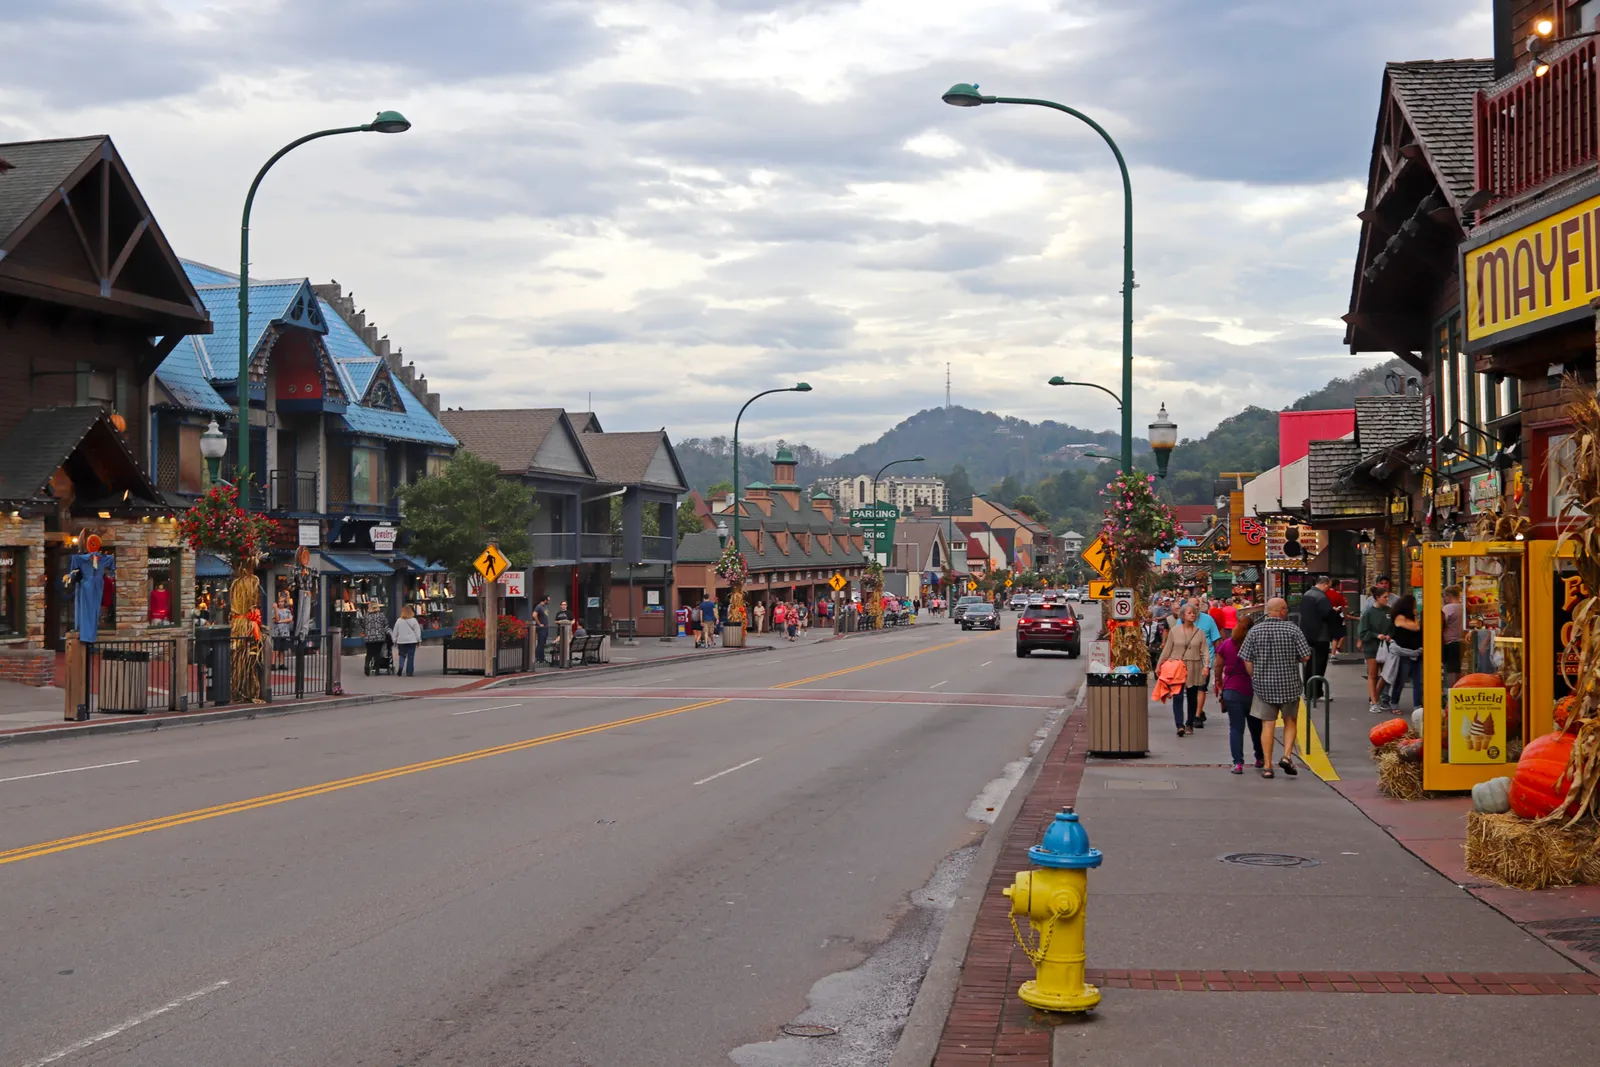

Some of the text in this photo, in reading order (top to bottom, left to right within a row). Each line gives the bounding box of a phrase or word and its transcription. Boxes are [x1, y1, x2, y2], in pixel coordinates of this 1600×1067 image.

[1476, 206, 1600, 328] MAYFI
[852, 510, 896, 518] PARKING
[1453, 692, 1503, 705] Mayfield
